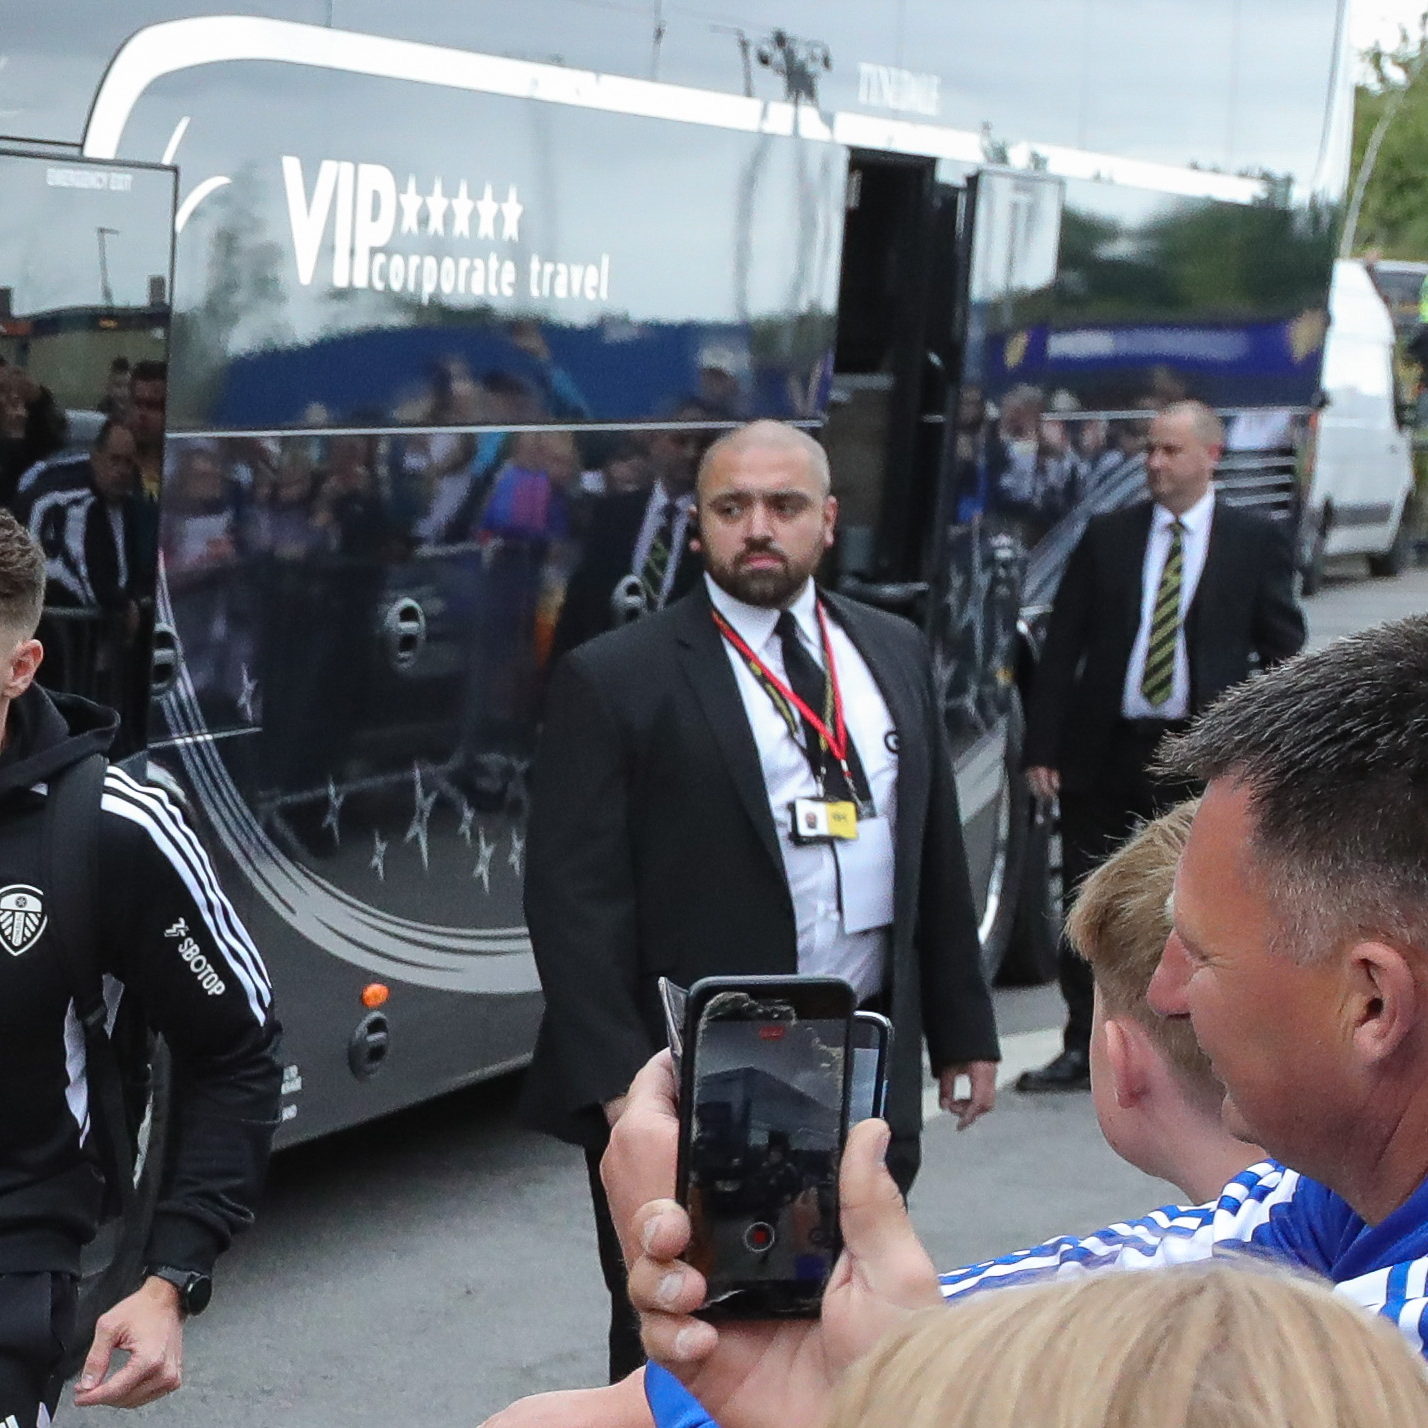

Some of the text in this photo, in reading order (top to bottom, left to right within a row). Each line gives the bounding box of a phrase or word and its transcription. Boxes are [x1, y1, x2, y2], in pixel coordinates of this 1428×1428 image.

[281, 155, 396, 288] VIP
[371, 251, 610, 306] corporate travel
[177, 937, 226, 996] SBOTOP
